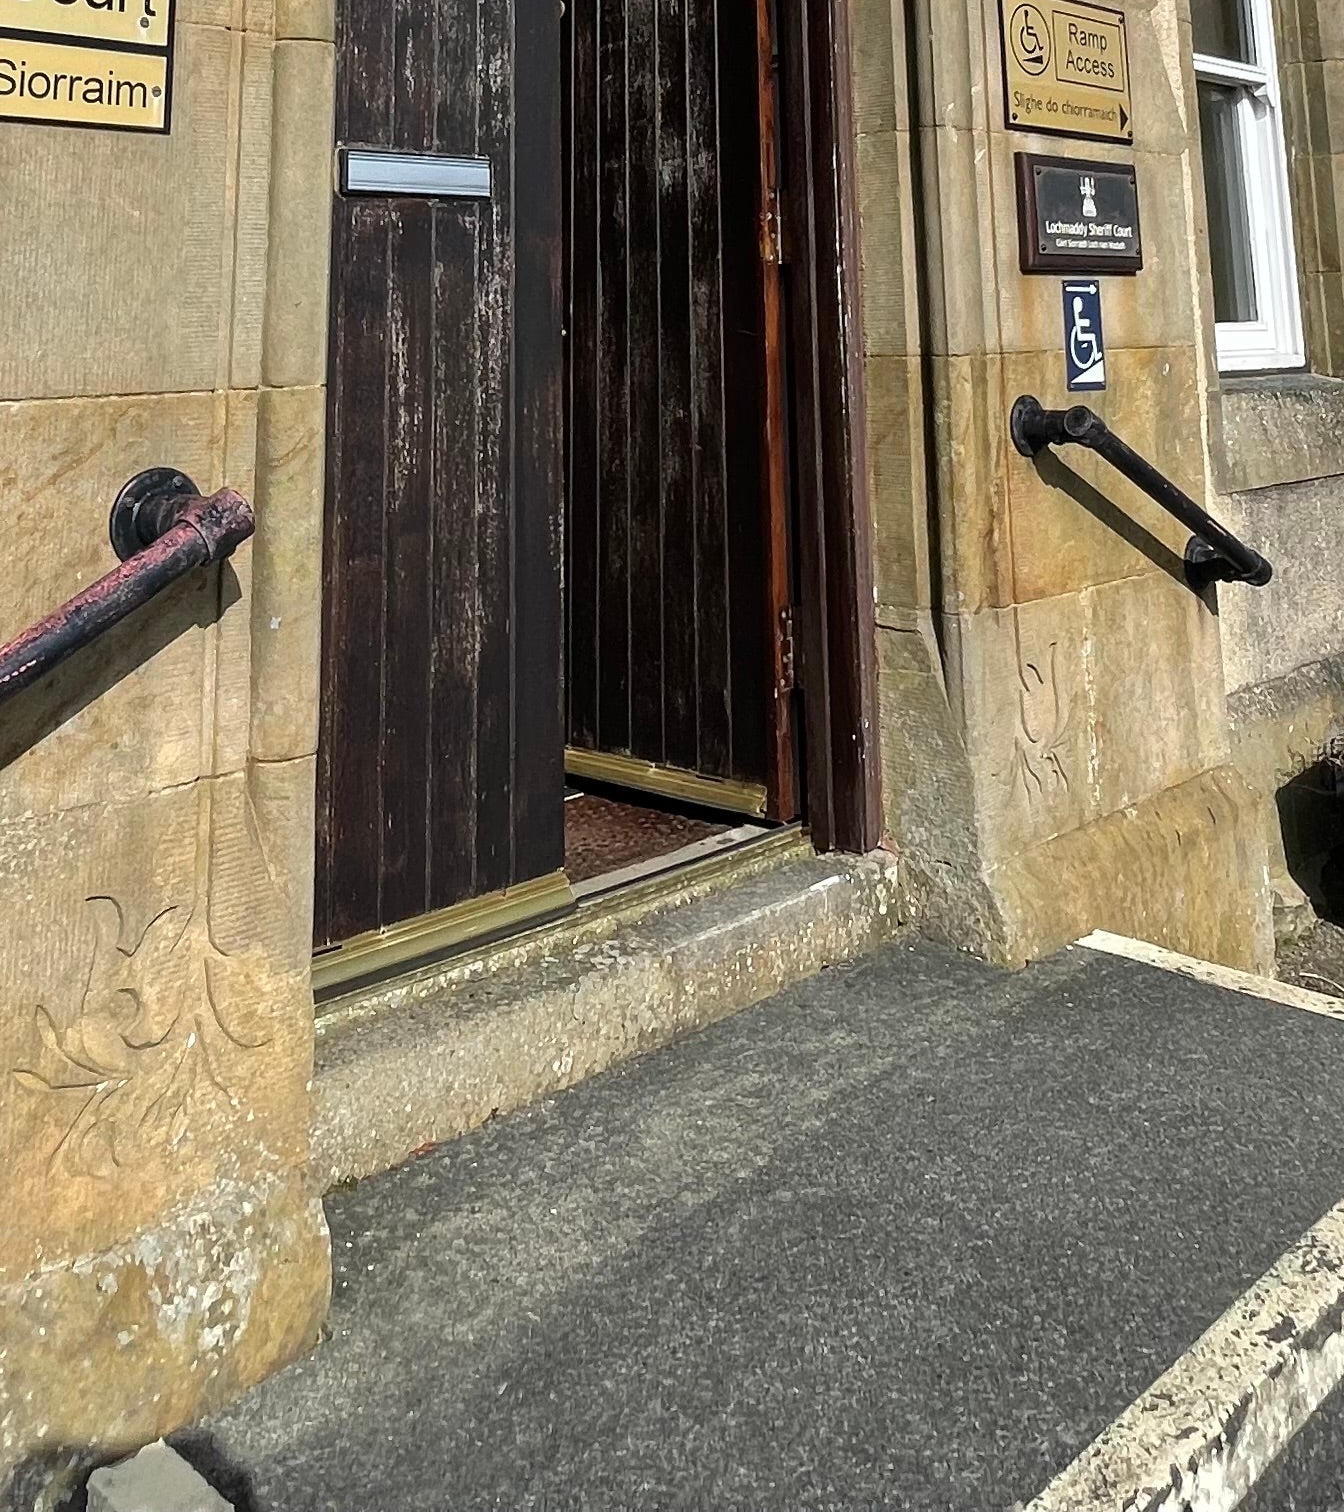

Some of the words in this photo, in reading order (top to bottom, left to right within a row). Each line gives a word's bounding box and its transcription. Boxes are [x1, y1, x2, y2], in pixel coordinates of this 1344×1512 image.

[1067, 22, 1107, 55] Ramp
[1065, 50, 1115, 79] Access
[1045, 96, 1059, 113] do
[1045, 220, 1088, 237] Lochmaddy
[1088, 222, 1113, 237] Sheriff
[1113, 224, 1133, 238] Court
